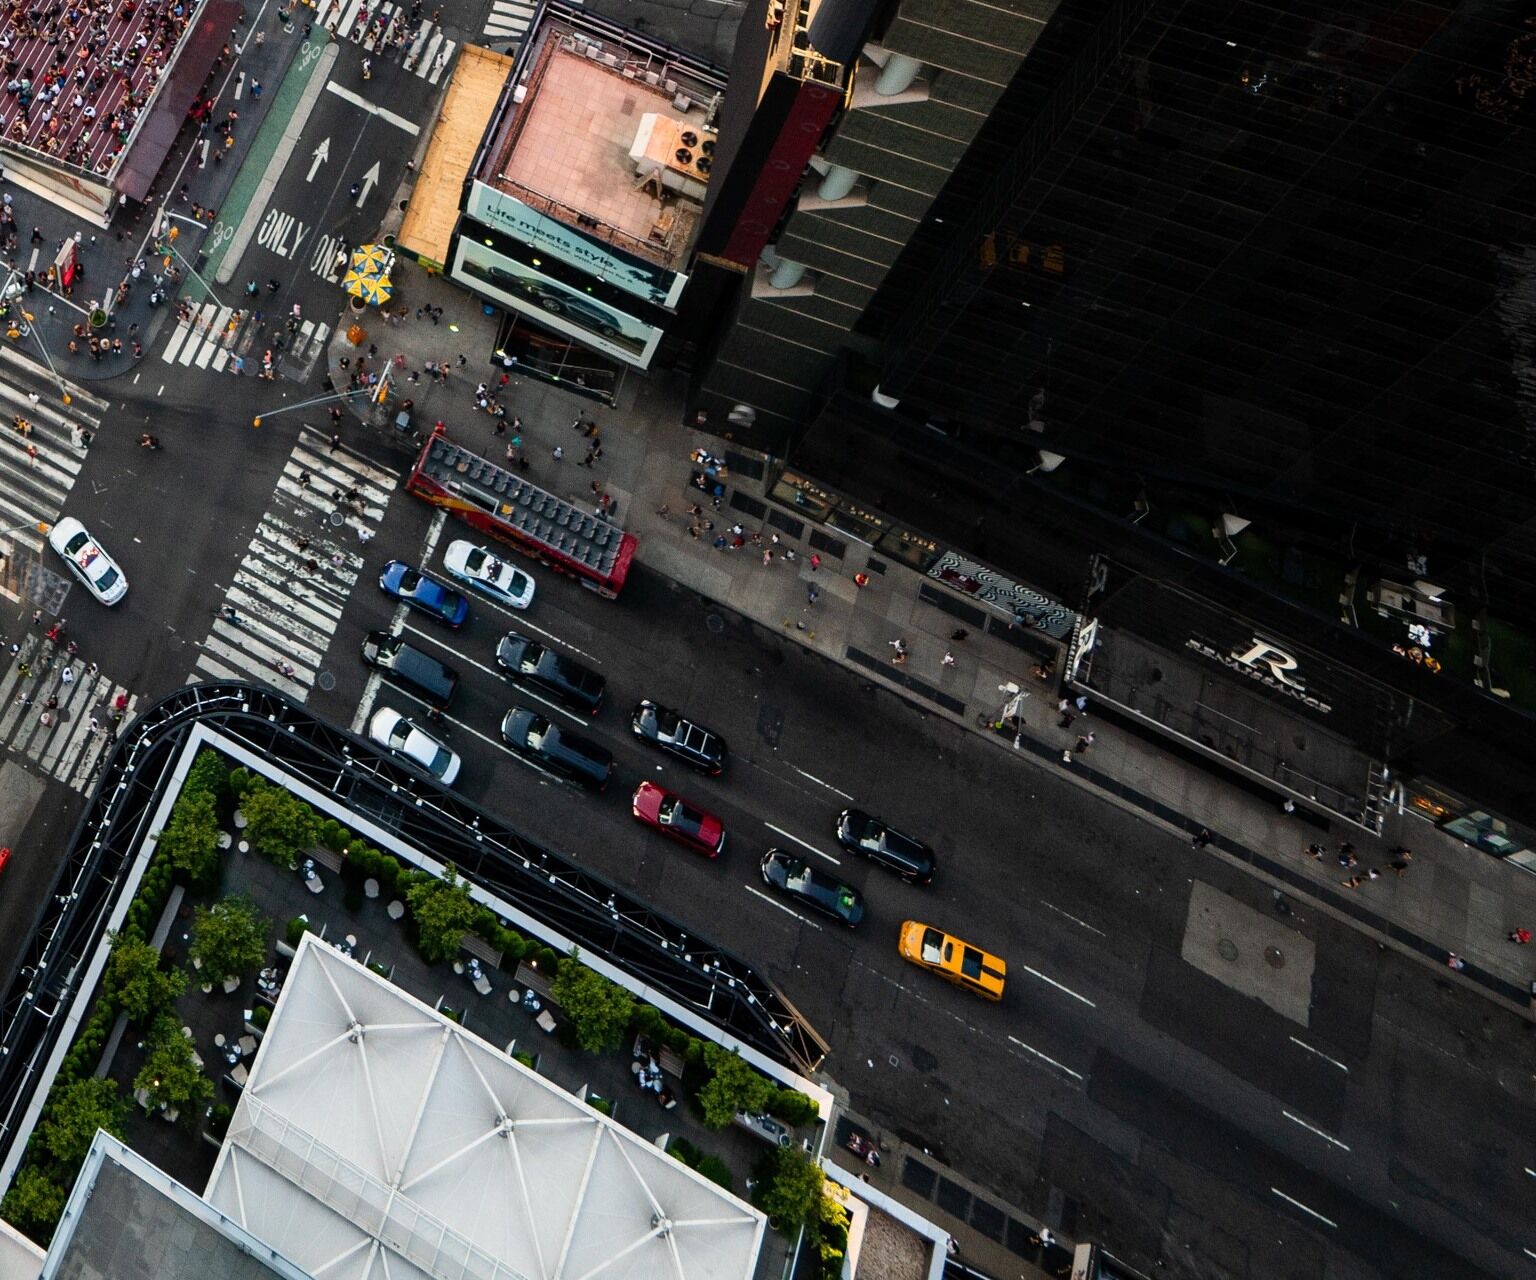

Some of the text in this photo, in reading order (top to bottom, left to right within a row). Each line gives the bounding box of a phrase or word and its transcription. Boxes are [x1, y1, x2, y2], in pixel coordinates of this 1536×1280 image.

[258, 208, 311, 260] ONLY
[487, 204, 517, 223] Life
[519, 220, 572, 249] meets
[575, 246, 617, 270] style.
[1230, 637, 1305, 691] R
